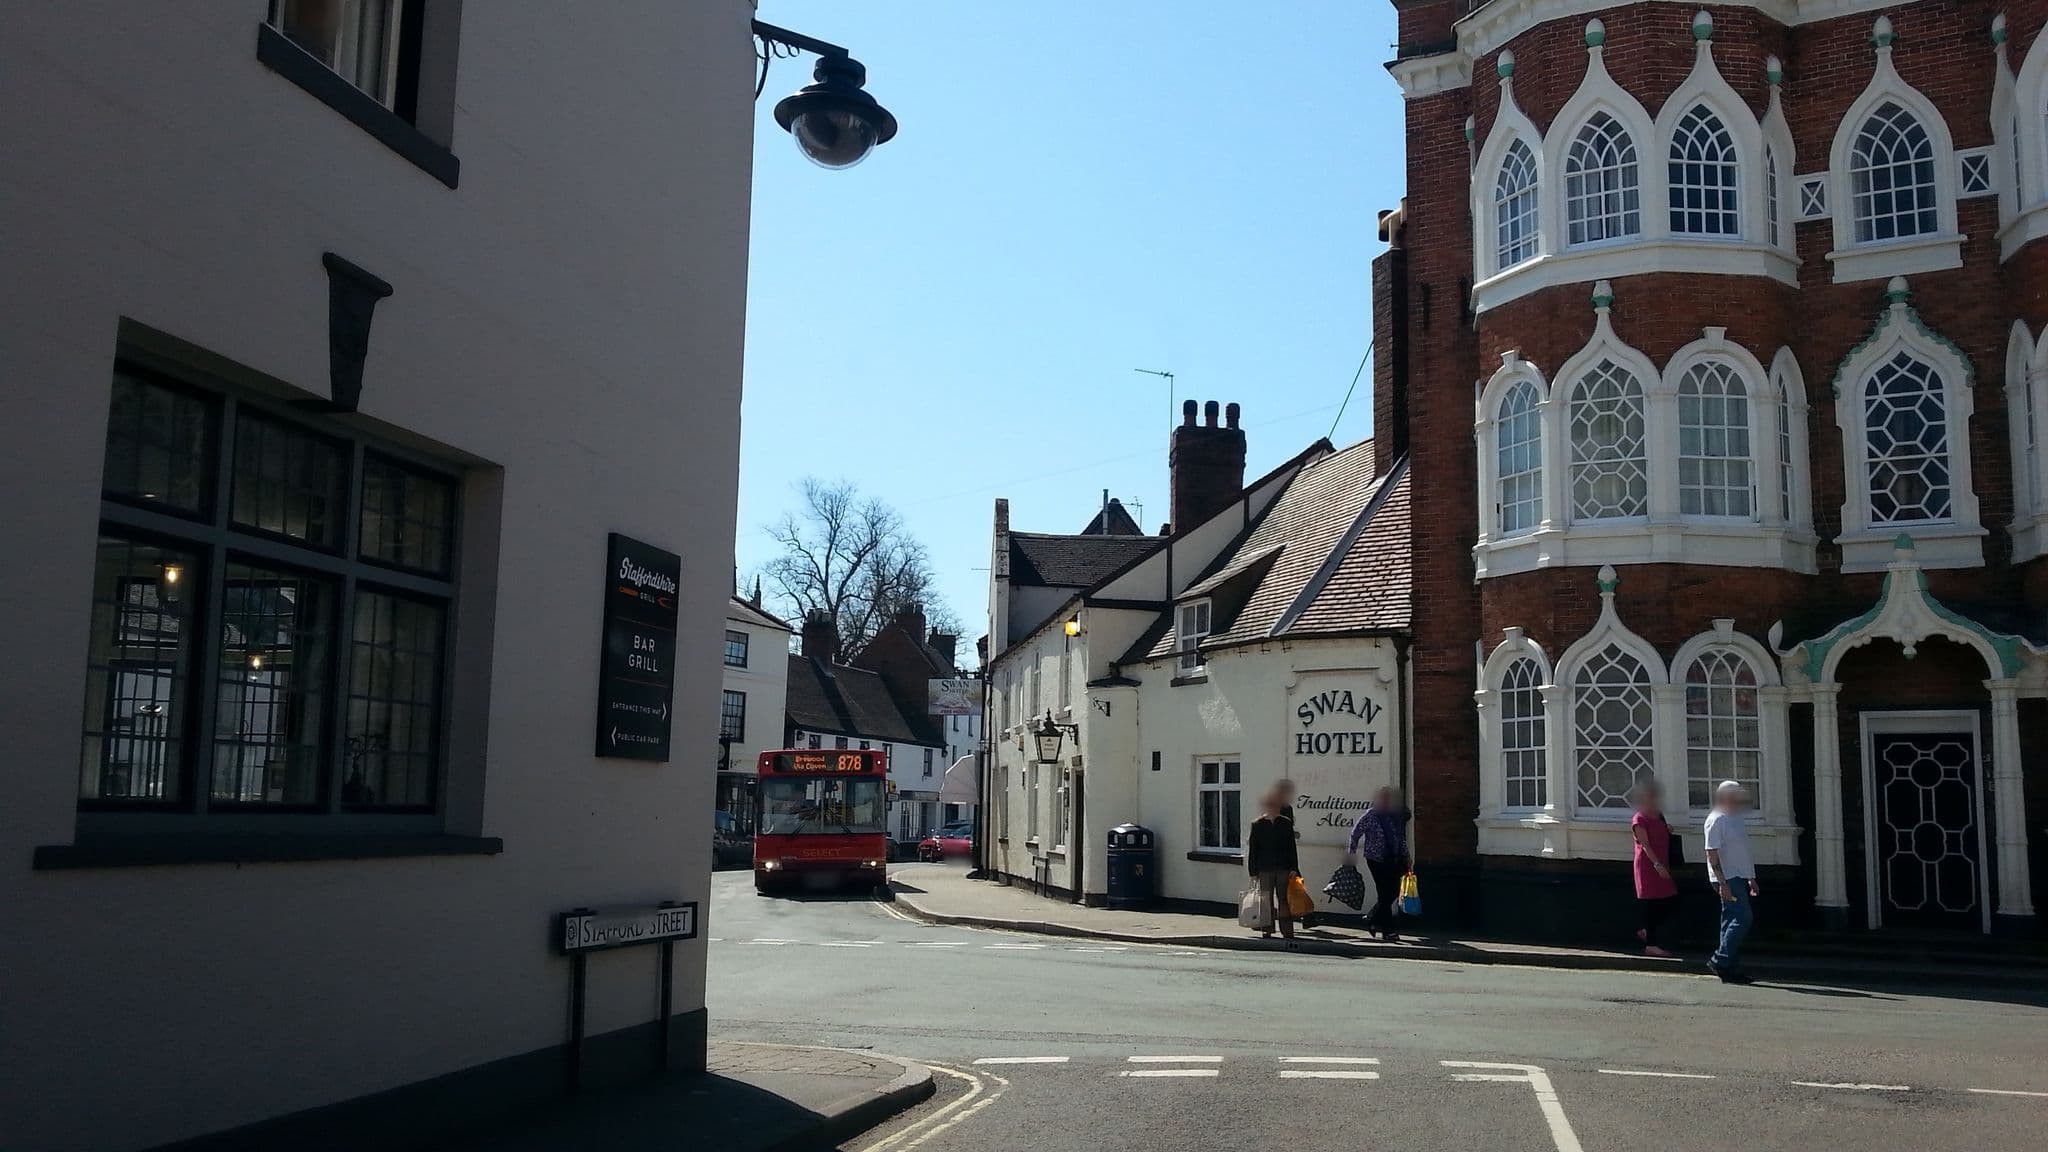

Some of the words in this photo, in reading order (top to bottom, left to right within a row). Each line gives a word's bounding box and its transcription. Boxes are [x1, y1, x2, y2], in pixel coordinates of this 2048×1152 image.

[619, 557, 676, 594] Staffordshire
[639, 592, 655, 604] GRILL
[633, 634, 656, 653] BAR
[628, 653, 658, 672] GRILL
[941, 679, 969, 693] SWAN
[612, 701, 638, 713] ENTRANCE
[1297, 690, 1383, 728] SWAN
[1295, 732, 1383, 754] HOTEL
[838, 755, 862, 771] 878
[1316, 812, 1355, 828] Ales
[802, 848, 841, 857] SELECT
